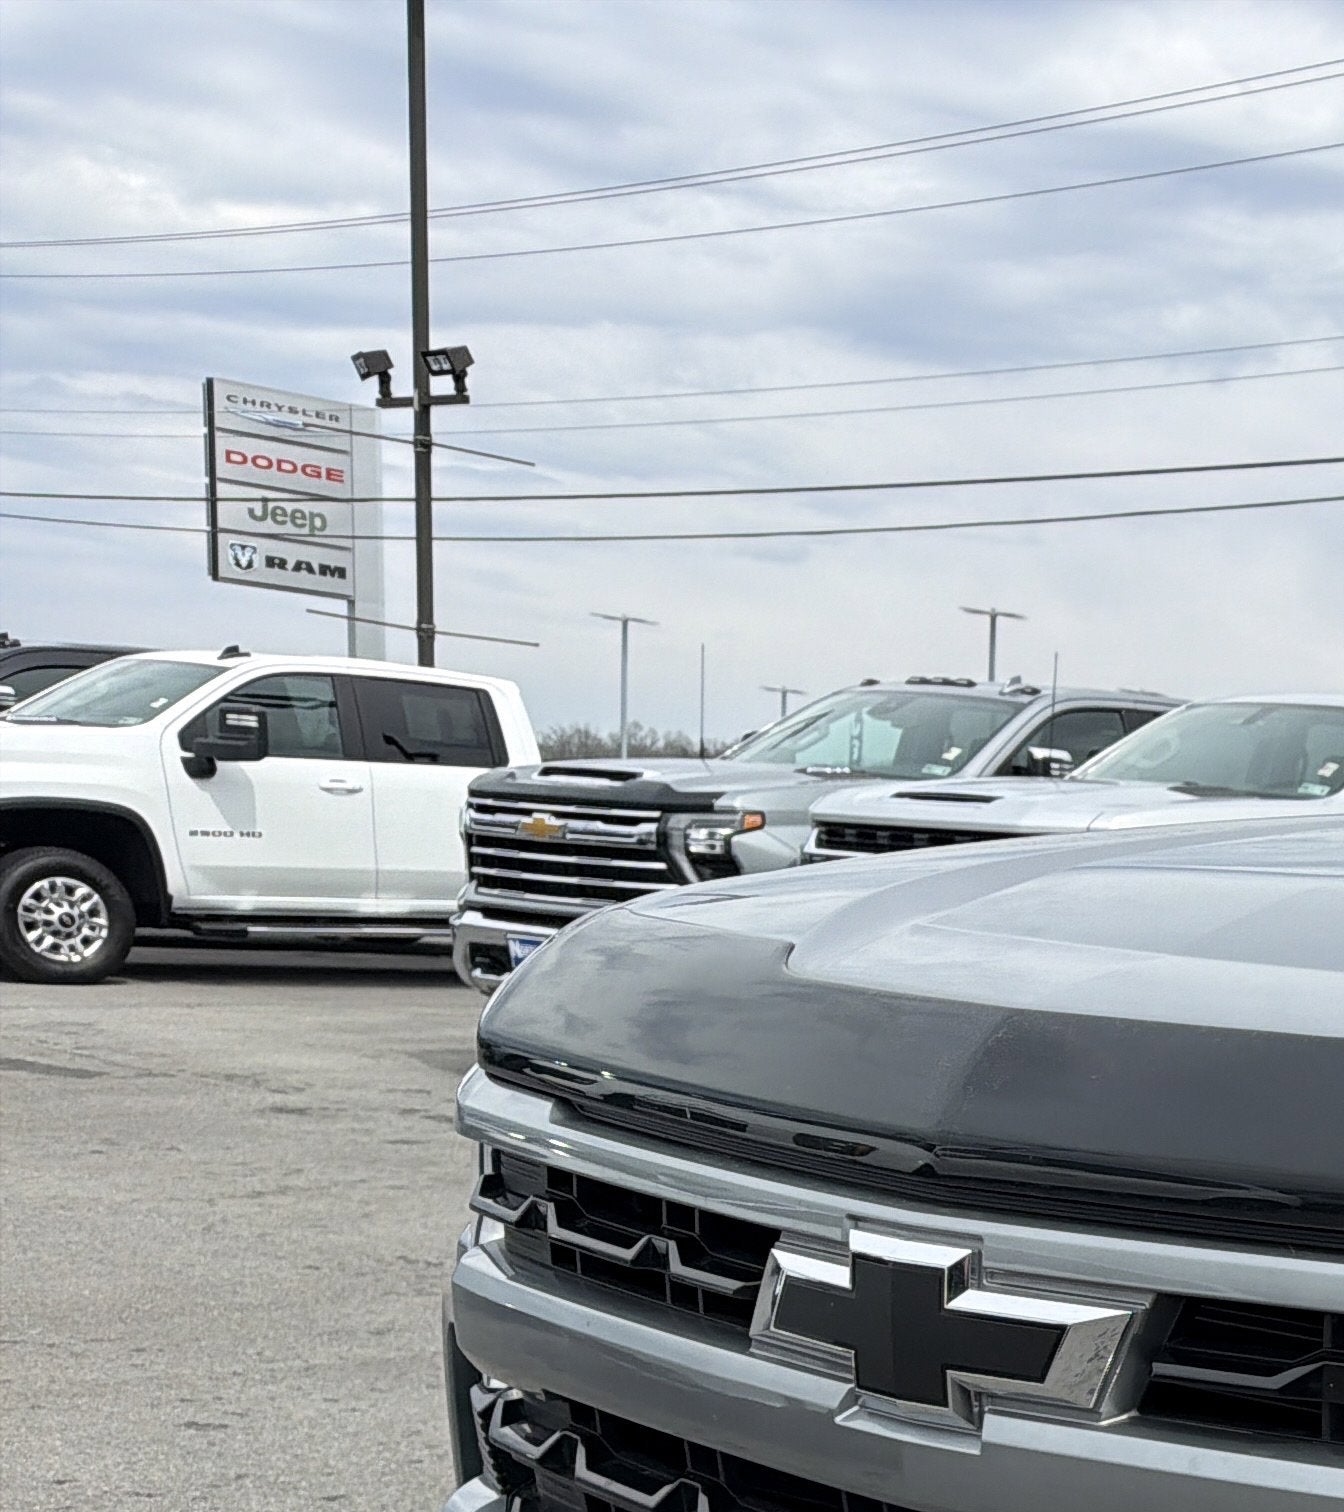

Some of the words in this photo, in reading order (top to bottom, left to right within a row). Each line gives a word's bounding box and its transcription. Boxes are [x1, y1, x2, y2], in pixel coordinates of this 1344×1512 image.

[225, 393, 341, 423] CHRYSLER
[224, 449, 345, 484] DODGE
[247, 496, 328, 534] Jeep
[264, 555, 347, 580] RAM
